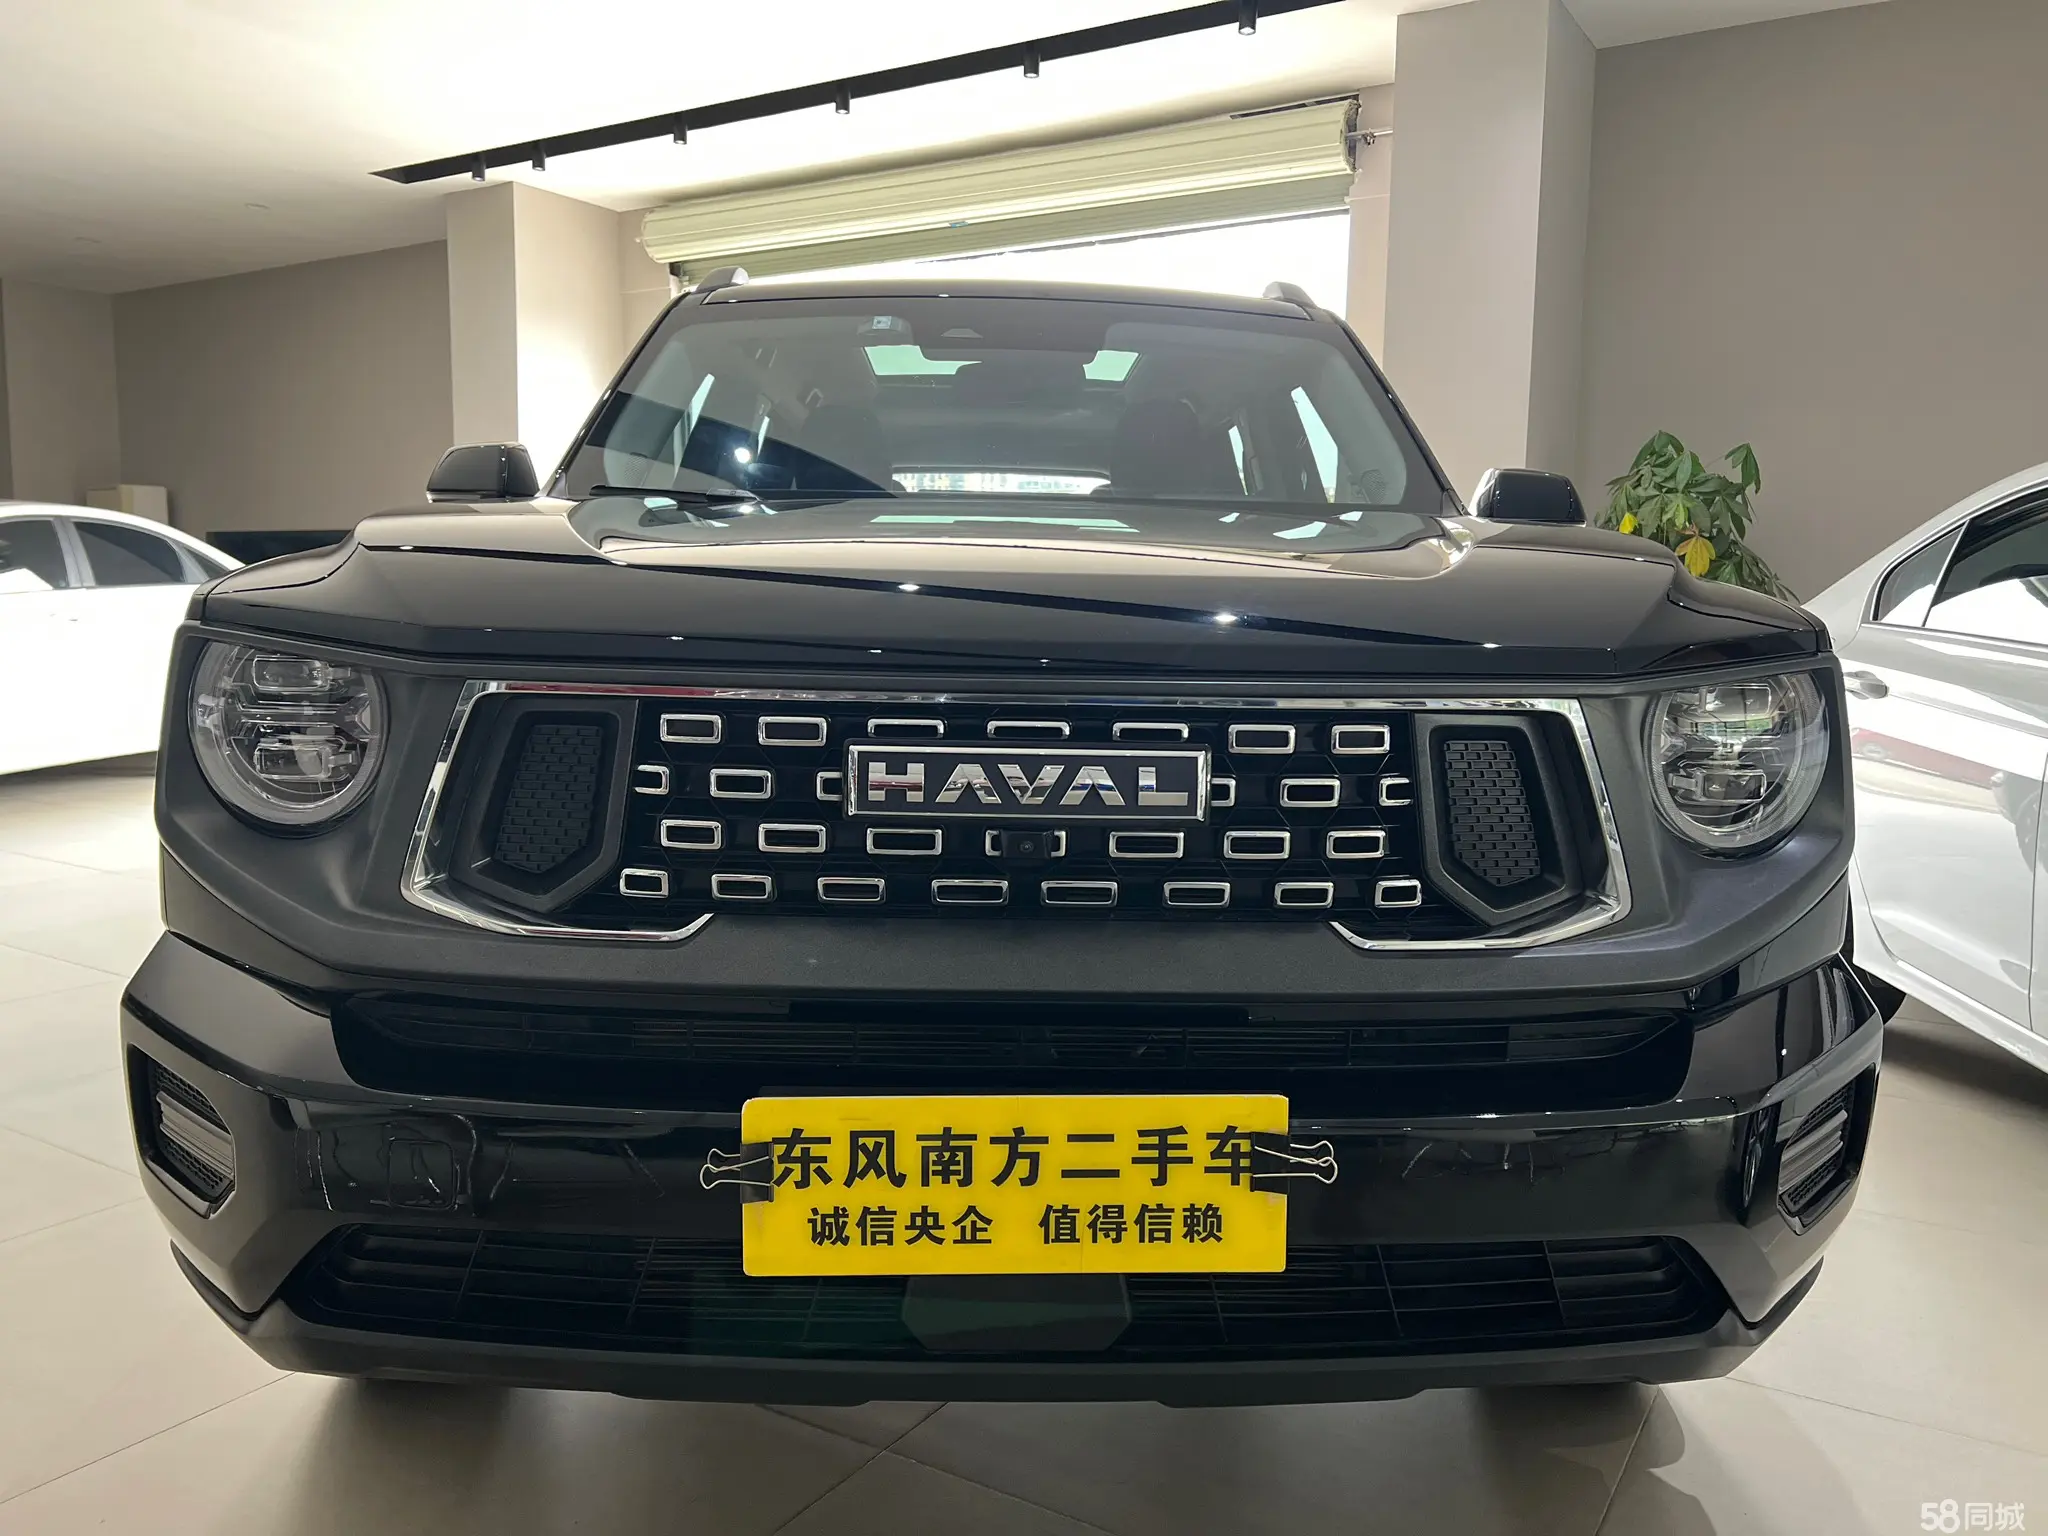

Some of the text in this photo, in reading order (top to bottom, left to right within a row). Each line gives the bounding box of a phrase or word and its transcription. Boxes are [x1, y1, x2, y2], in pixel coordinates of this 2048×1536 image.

[868, 762, 1188, 806] HAVAL
[771, 1125, 1251, 1189] 东风南方二手车
[808, 1202, 1224, 1247] 诚信央企 值得信赖
